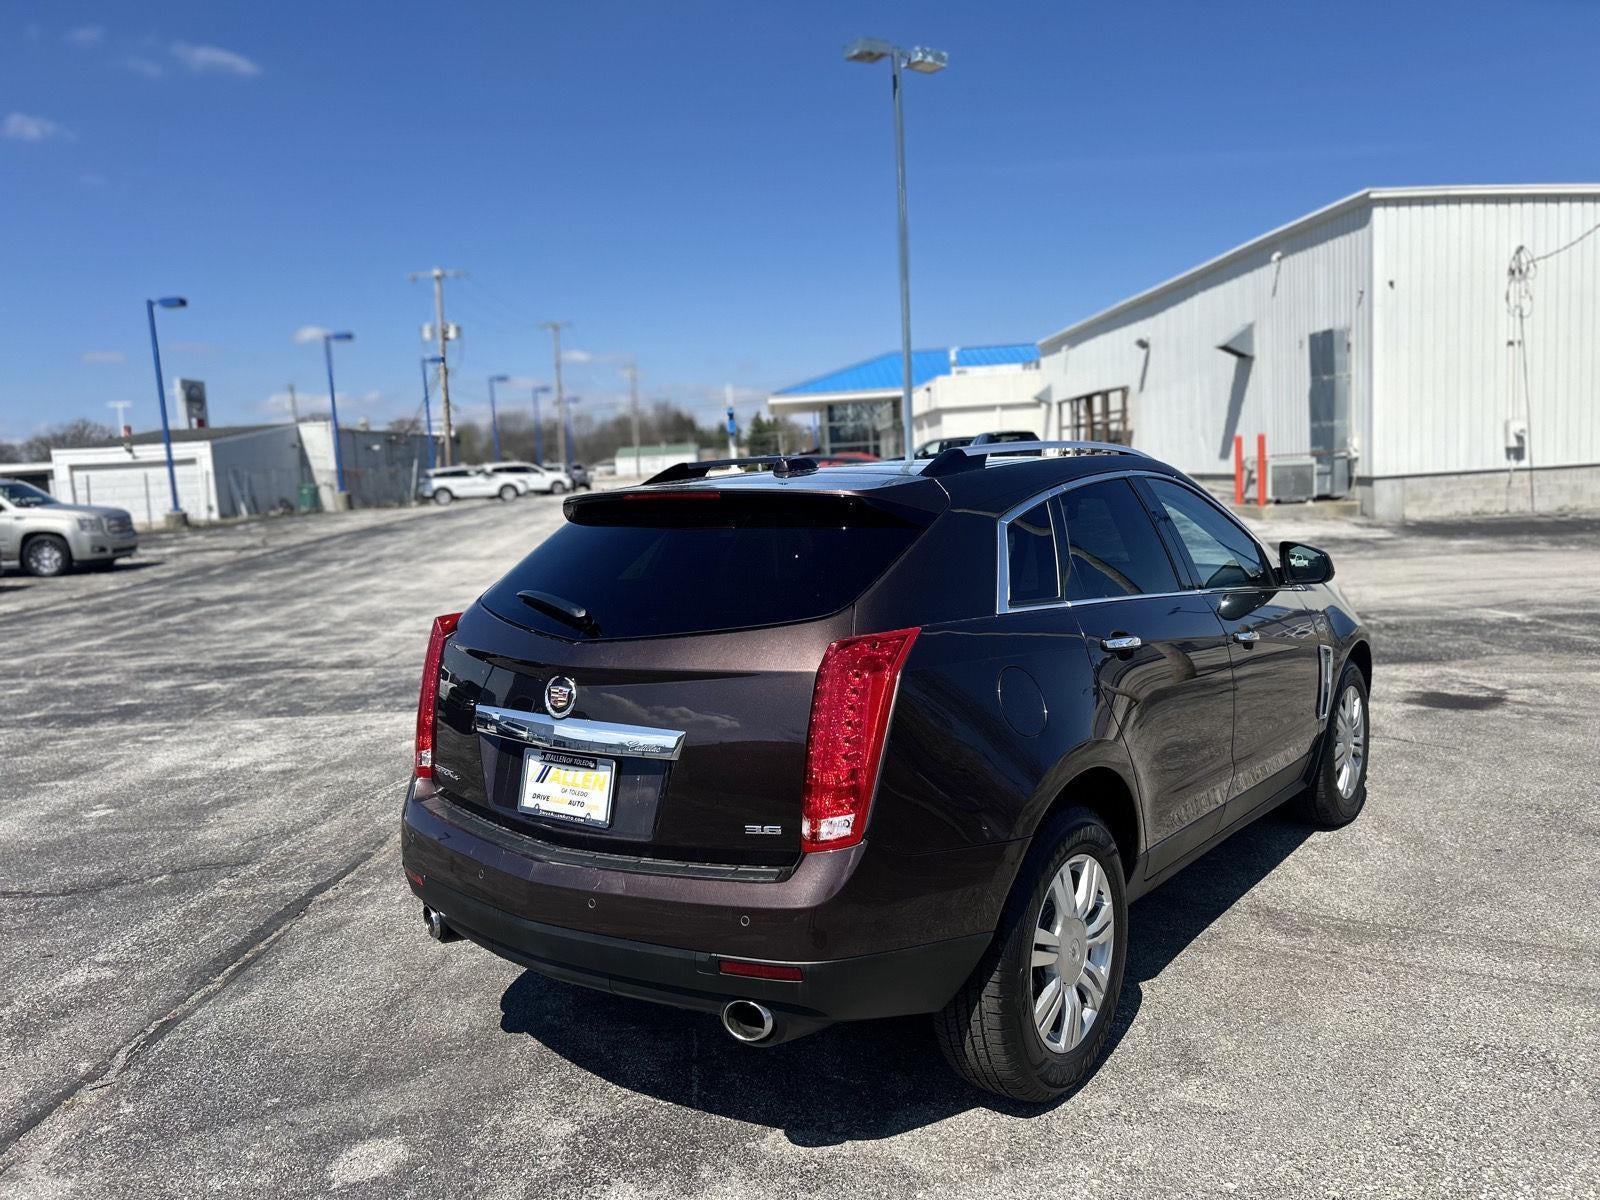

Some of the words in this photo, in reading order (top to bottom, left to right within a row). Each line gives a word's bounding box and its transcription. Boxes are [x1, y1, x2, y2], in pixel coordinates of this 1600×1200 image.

[626, 740, 661, 753] Cadillac
[549, 754, 566, 764] ALLEN
[573, 758, 592, 768] TOLEDO
[549, 768, 608, 792] ALLEN
[561, 787, 569, 795] OF
[569, 788, 589, 798] TOLEDO
[532, 793, 551, 802] DRIVE
[567, 800, 585, 808] AUTO
